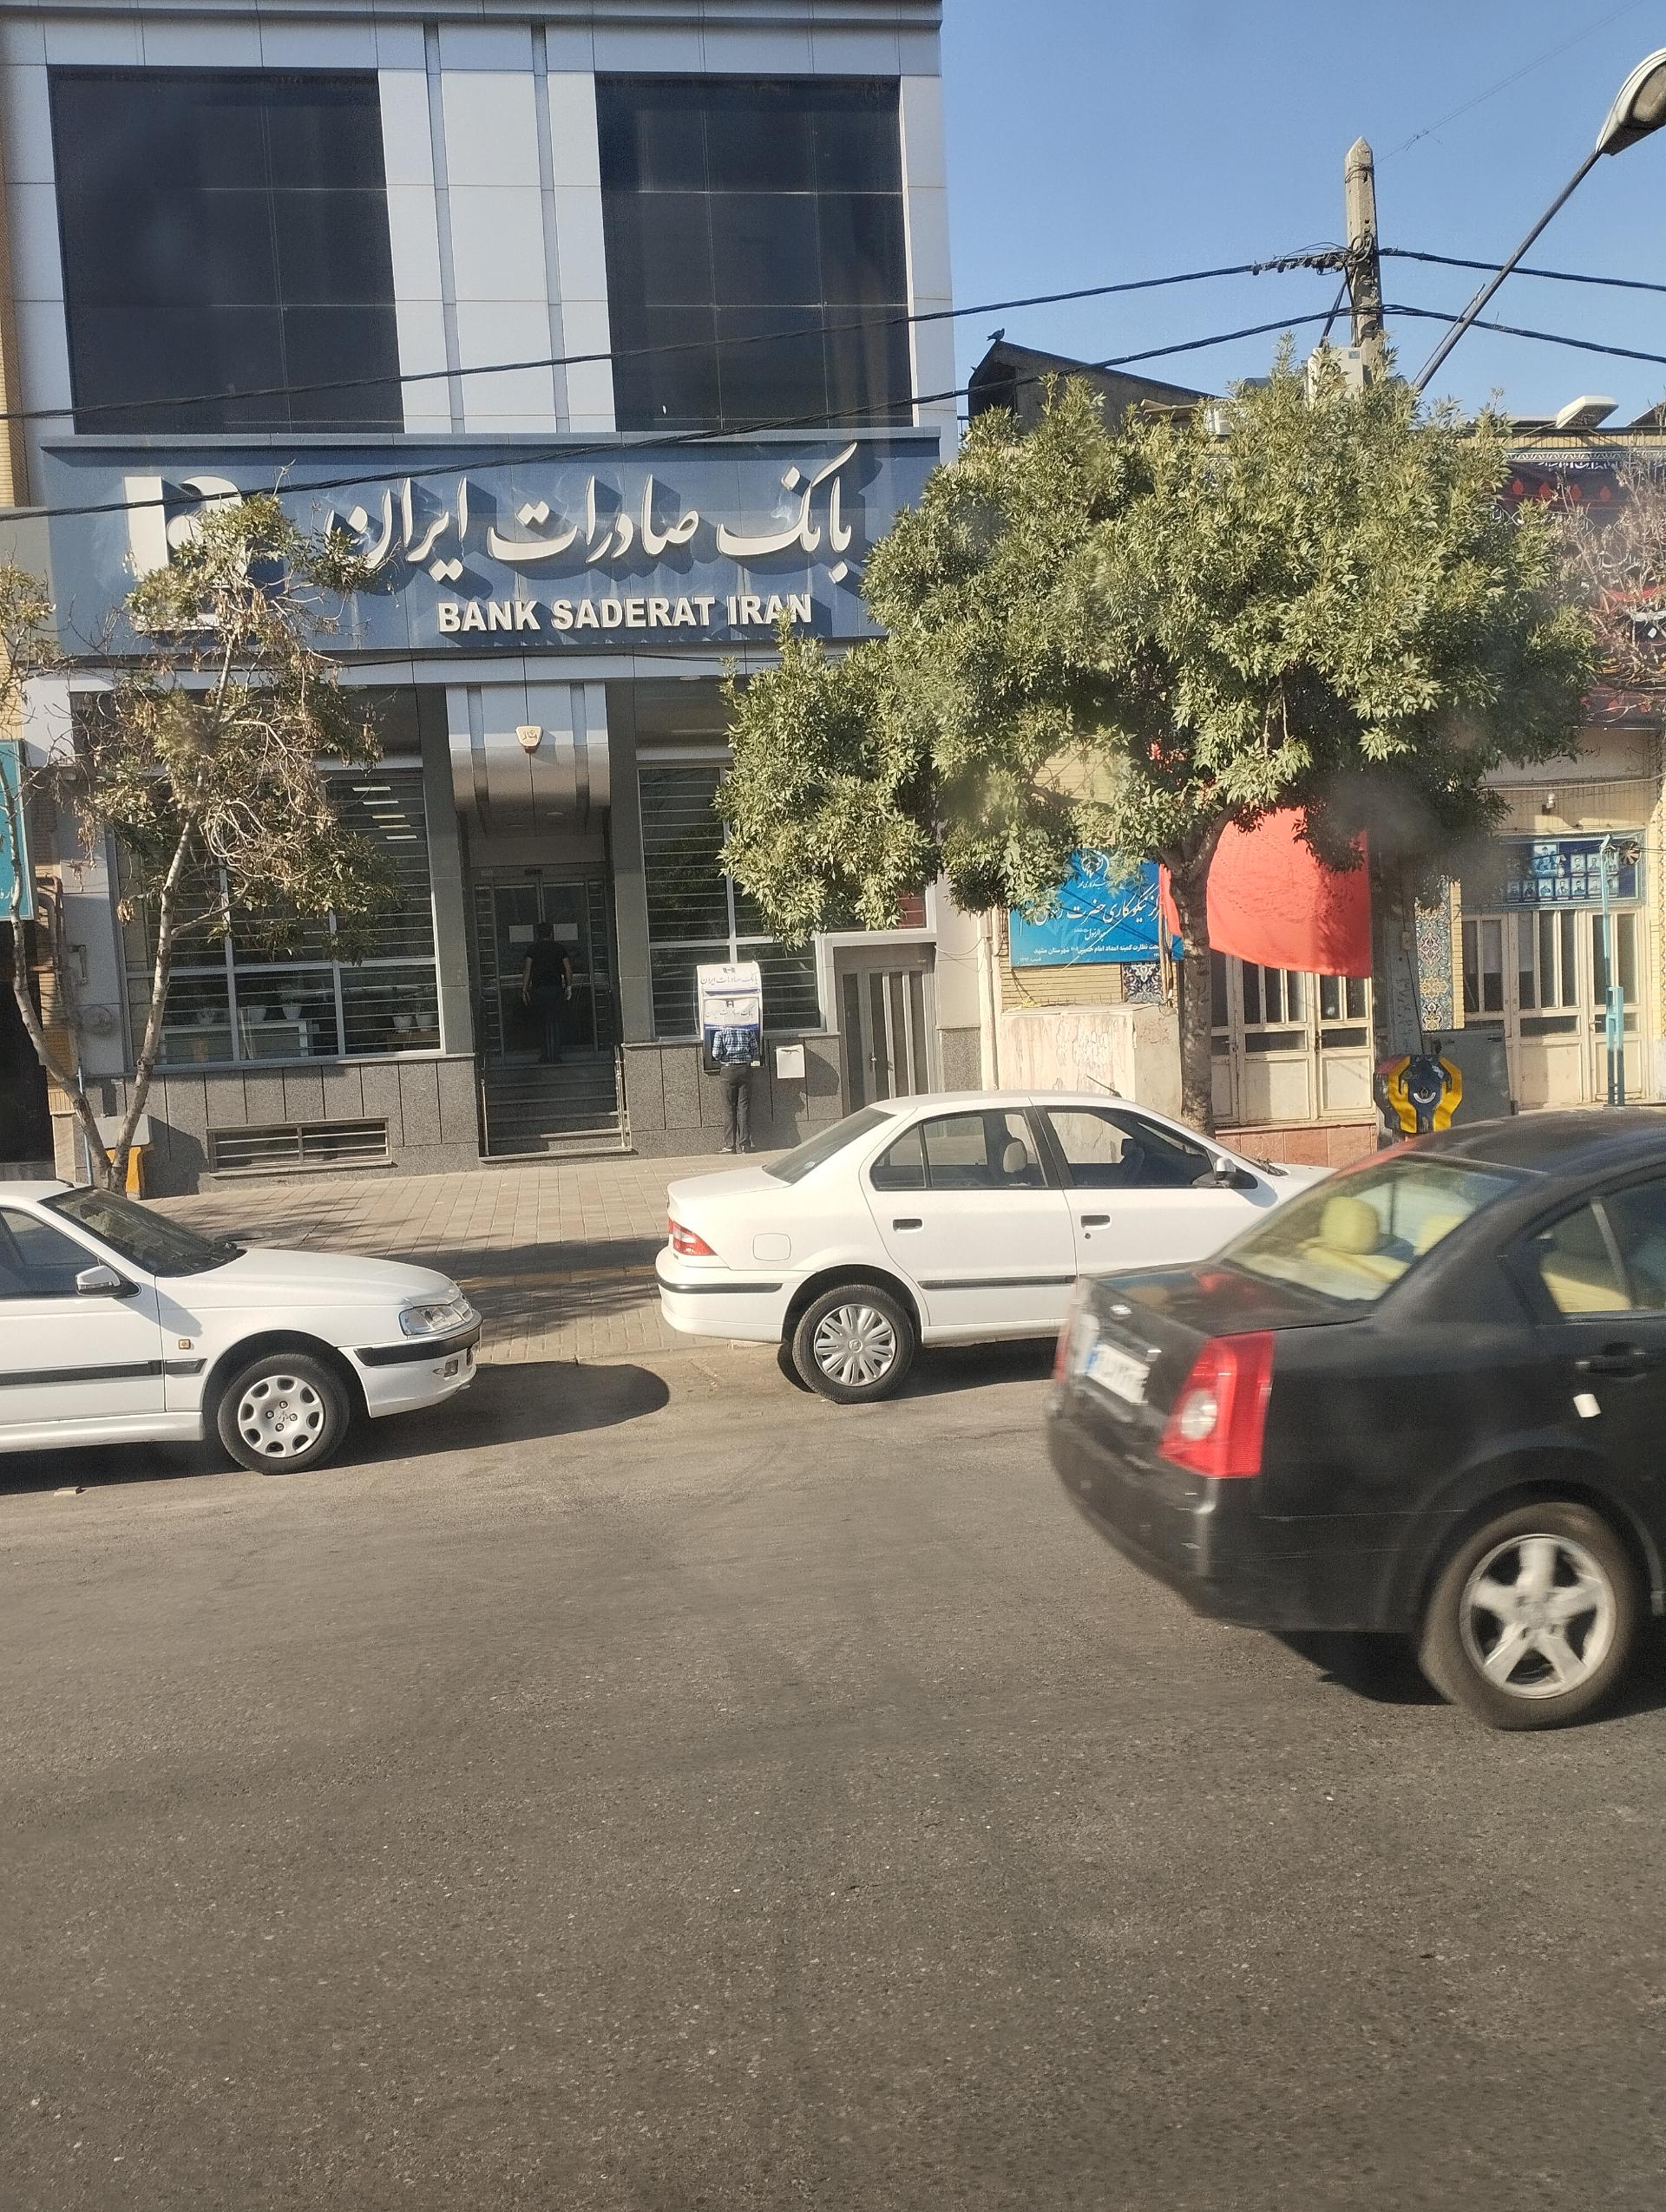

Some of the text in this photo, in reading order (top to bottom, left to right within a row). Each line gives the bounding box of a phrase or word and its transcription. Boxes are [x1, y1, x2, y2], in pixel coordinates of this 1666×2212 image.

[322, 441, 858, 583] بانک صادرات ایران
[437, 592, 813, 633] BANK SADERAT IRAN
